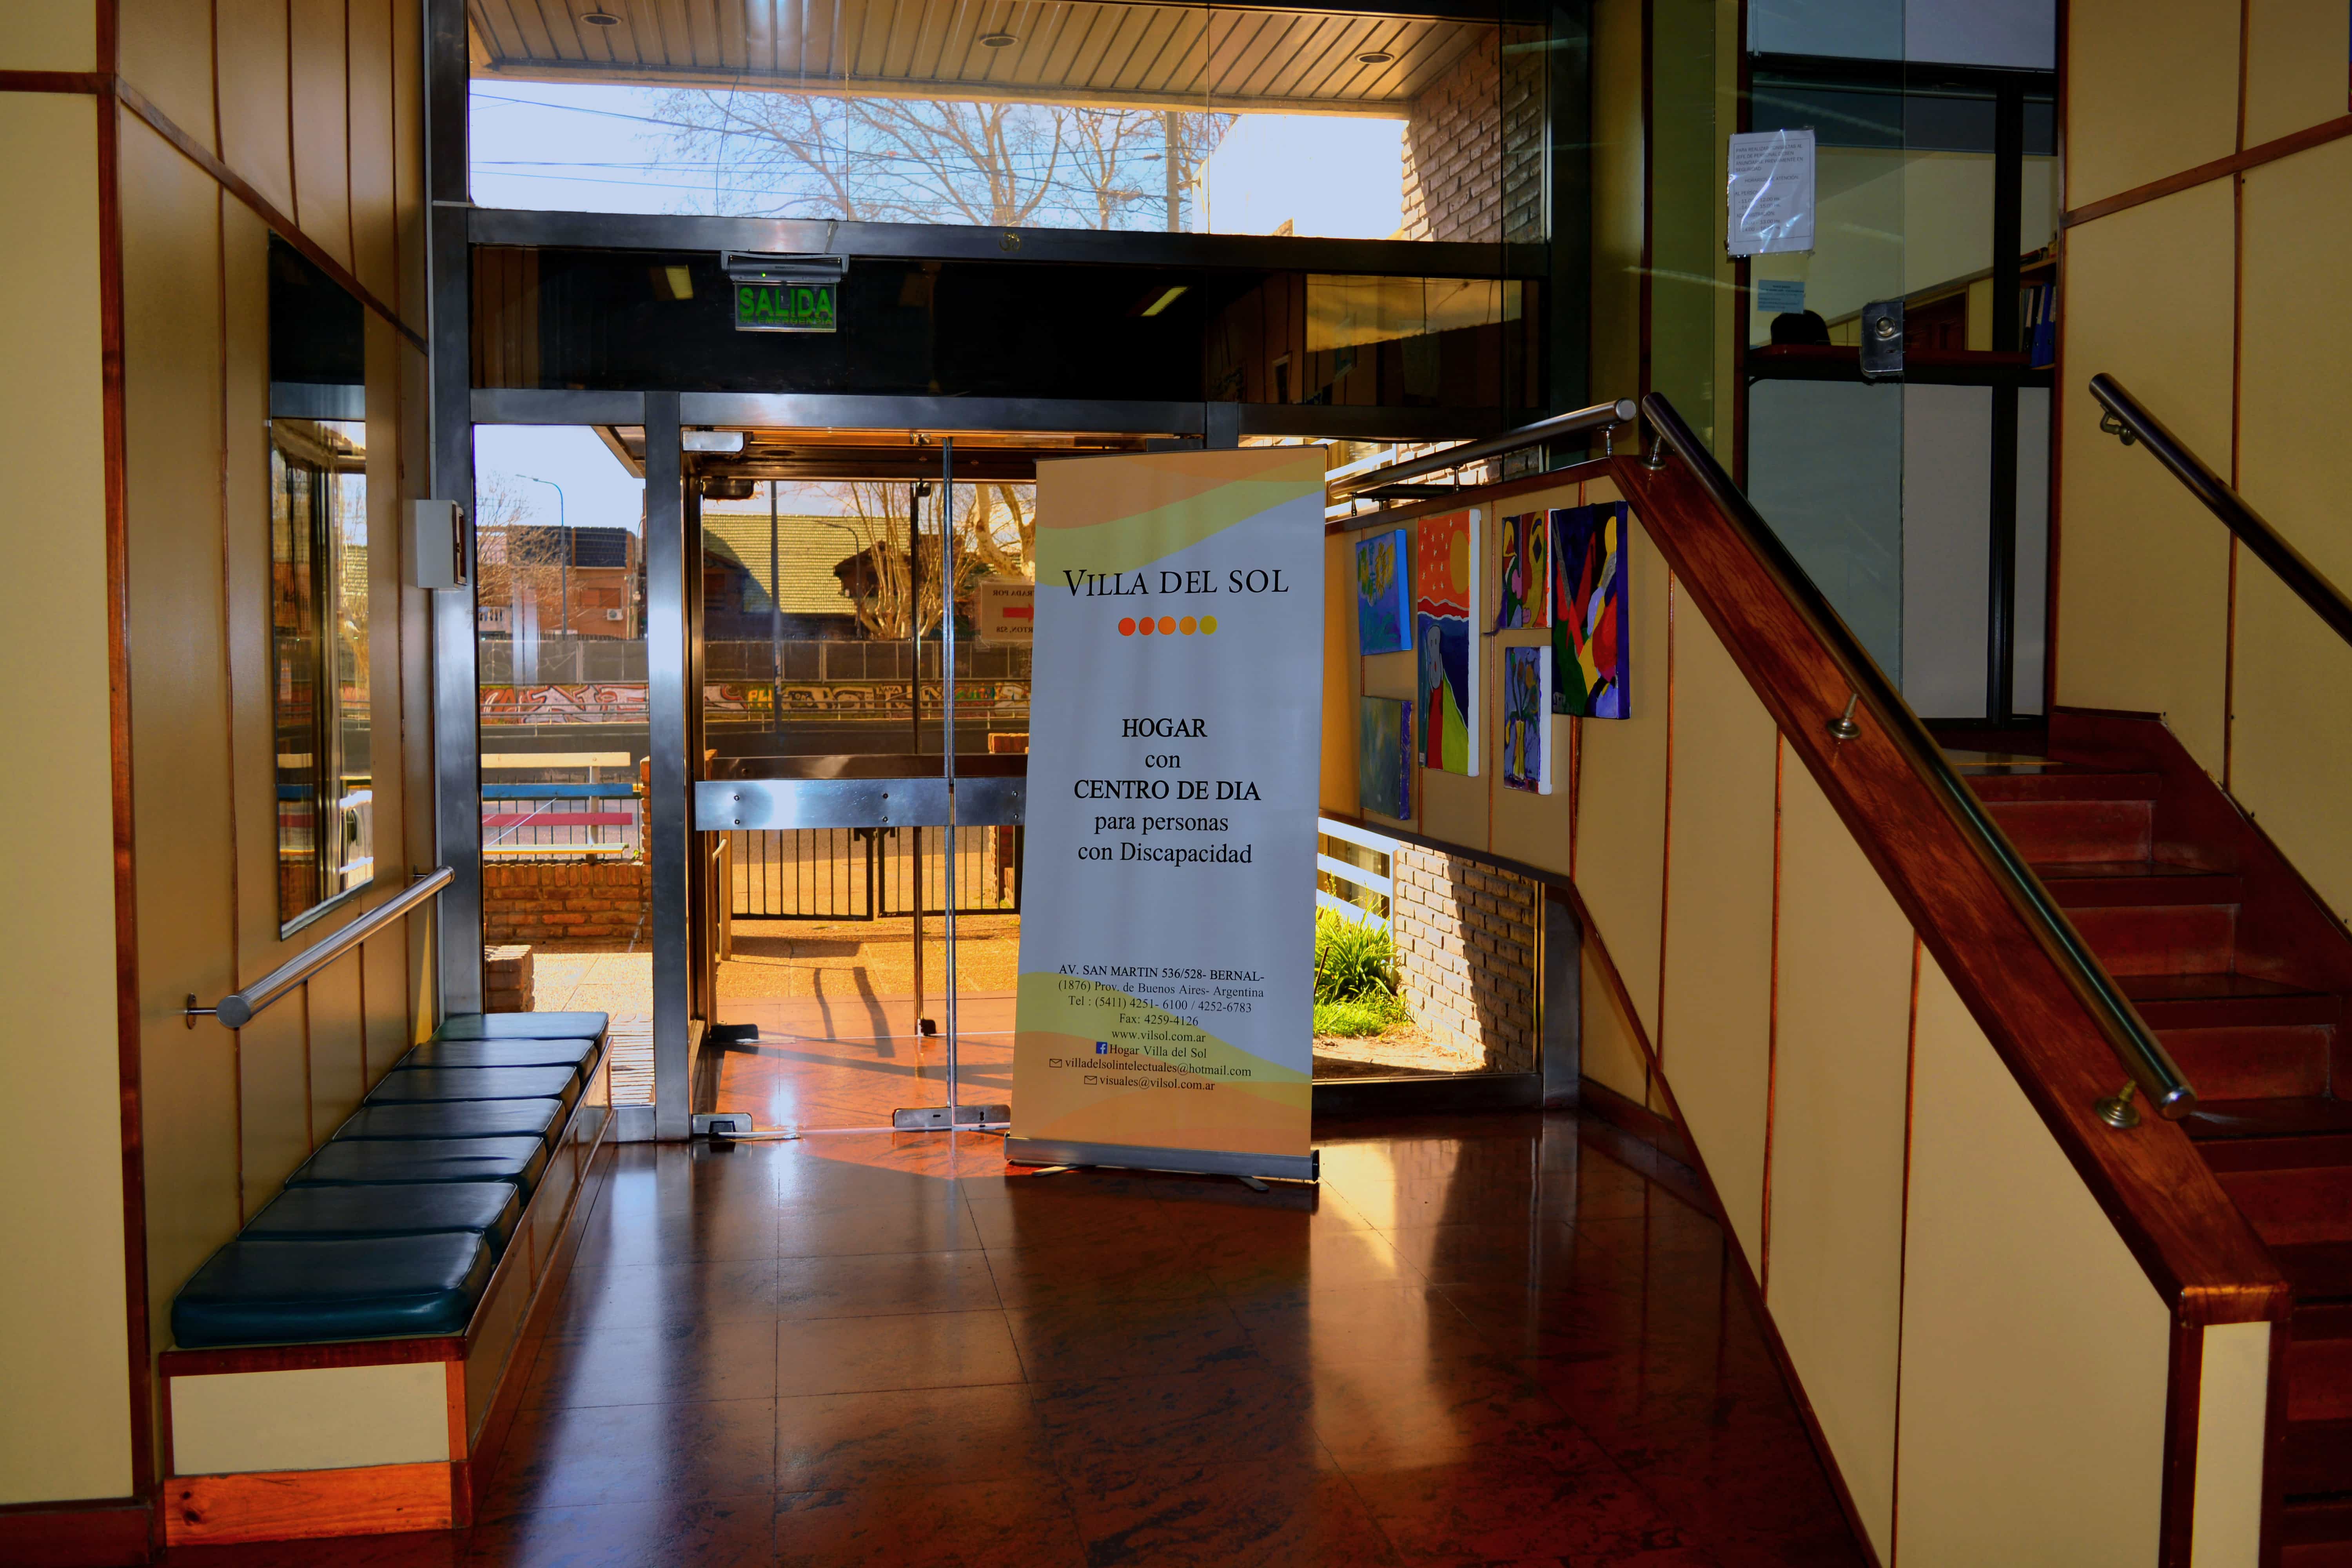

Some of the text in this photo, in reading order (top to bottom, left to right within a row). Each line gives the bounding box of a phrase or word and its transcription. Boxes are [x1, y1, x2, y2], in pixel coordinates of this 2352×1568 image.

[739, 287, 834, 317] SALIDA
[1062, 569, 1289, 596] VILLA DEL SOL
[1122, 718, 1208, 737] HOGAR
[1145, 755, 1181, 768] con
[1074, 779, 1262, 800] CENTRO DE DIA
[1094, 816, 1229, 835] para personas
[1078, 842, 1252, 867] con Discapacidad
[1058, 964, 1265, 982] AV. SAN MARTIN 536/528- BERNAL-
[1058, 980, 1264, 999] (1876) Prov. de Buenos Aires- Argentina
[1068, 995, 1084, 1005] Tel
[1095, 997, 1126, 1009] (5411)
[1129, 998, 1159, 1009] 4251-
[1163, 999, 1187, 1010] 6100
[1198, 1001, 1251, 1013] 4252-6783
[1119, 1013, 1198, 1026] Fax: 4259-4126
[1112, 1030, 1206, 1042] www.vilsol.com.ar
[1110, 1044, 1140, 1057] Hogar
[1143, 1045, 1168, 1056] Villa
[1171, 1047, 1186, 1057] del
[1191, 1047, 1206, 1058] Sol
[1065, 1058, 1251, 1076] villadelsolintelectuales@hotmail.com
[1100, 1076, 1215, 1091] visuales@vilsol.com.ar
